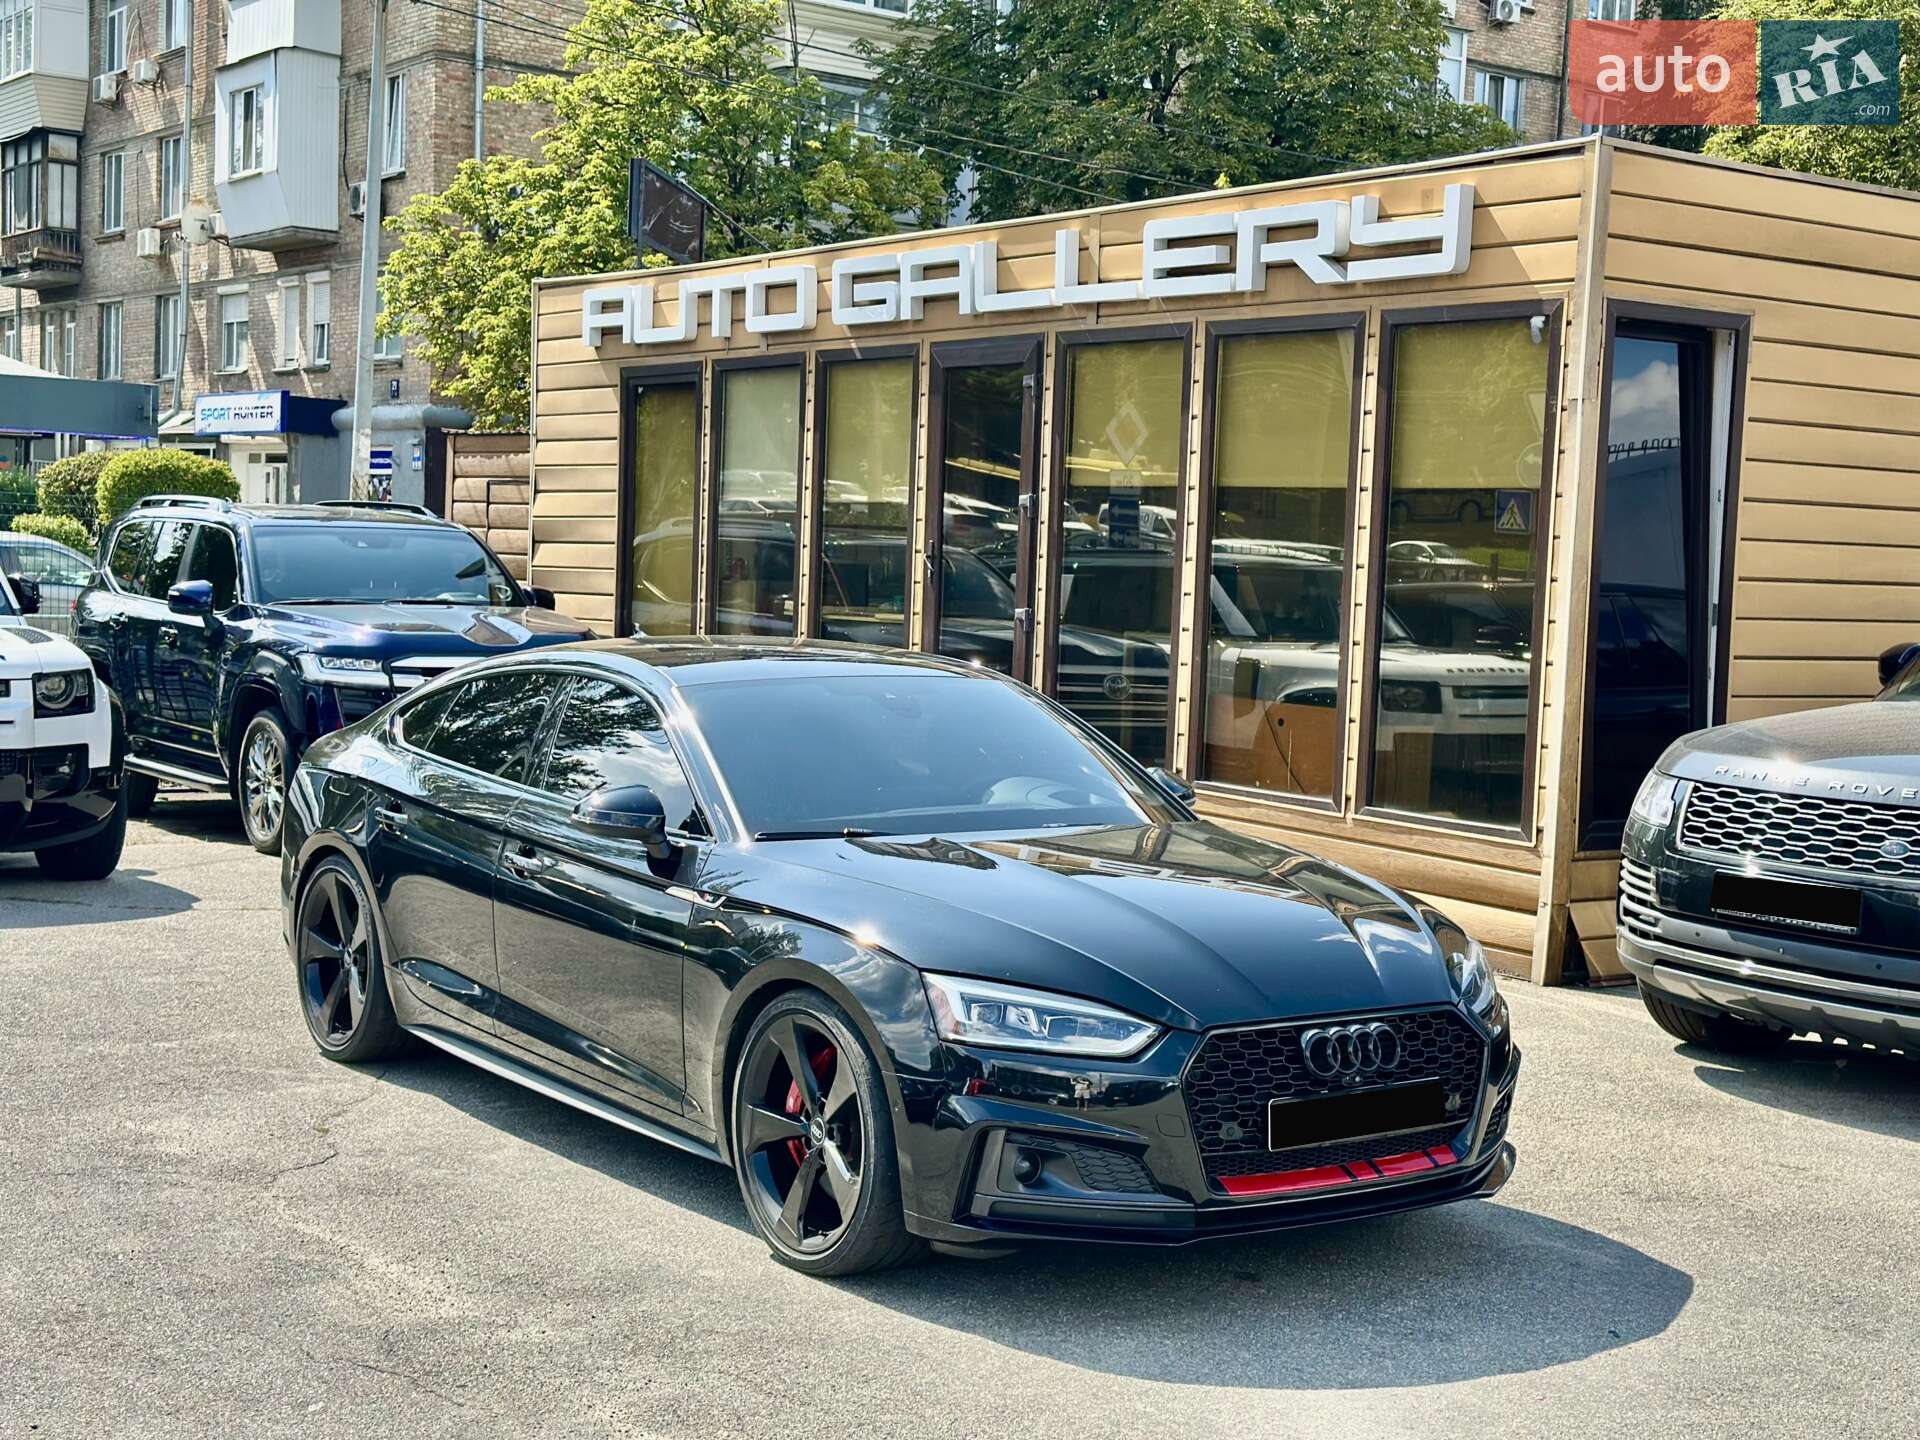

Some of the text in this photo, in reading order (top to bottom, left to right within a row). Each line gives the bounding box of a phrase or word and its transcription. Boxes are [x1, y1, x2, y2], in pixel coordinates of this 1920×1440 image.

[583, 183, 1475, 348] AUTO GALLERY
[200, 405, 273, 421] SPORT HUNTER
